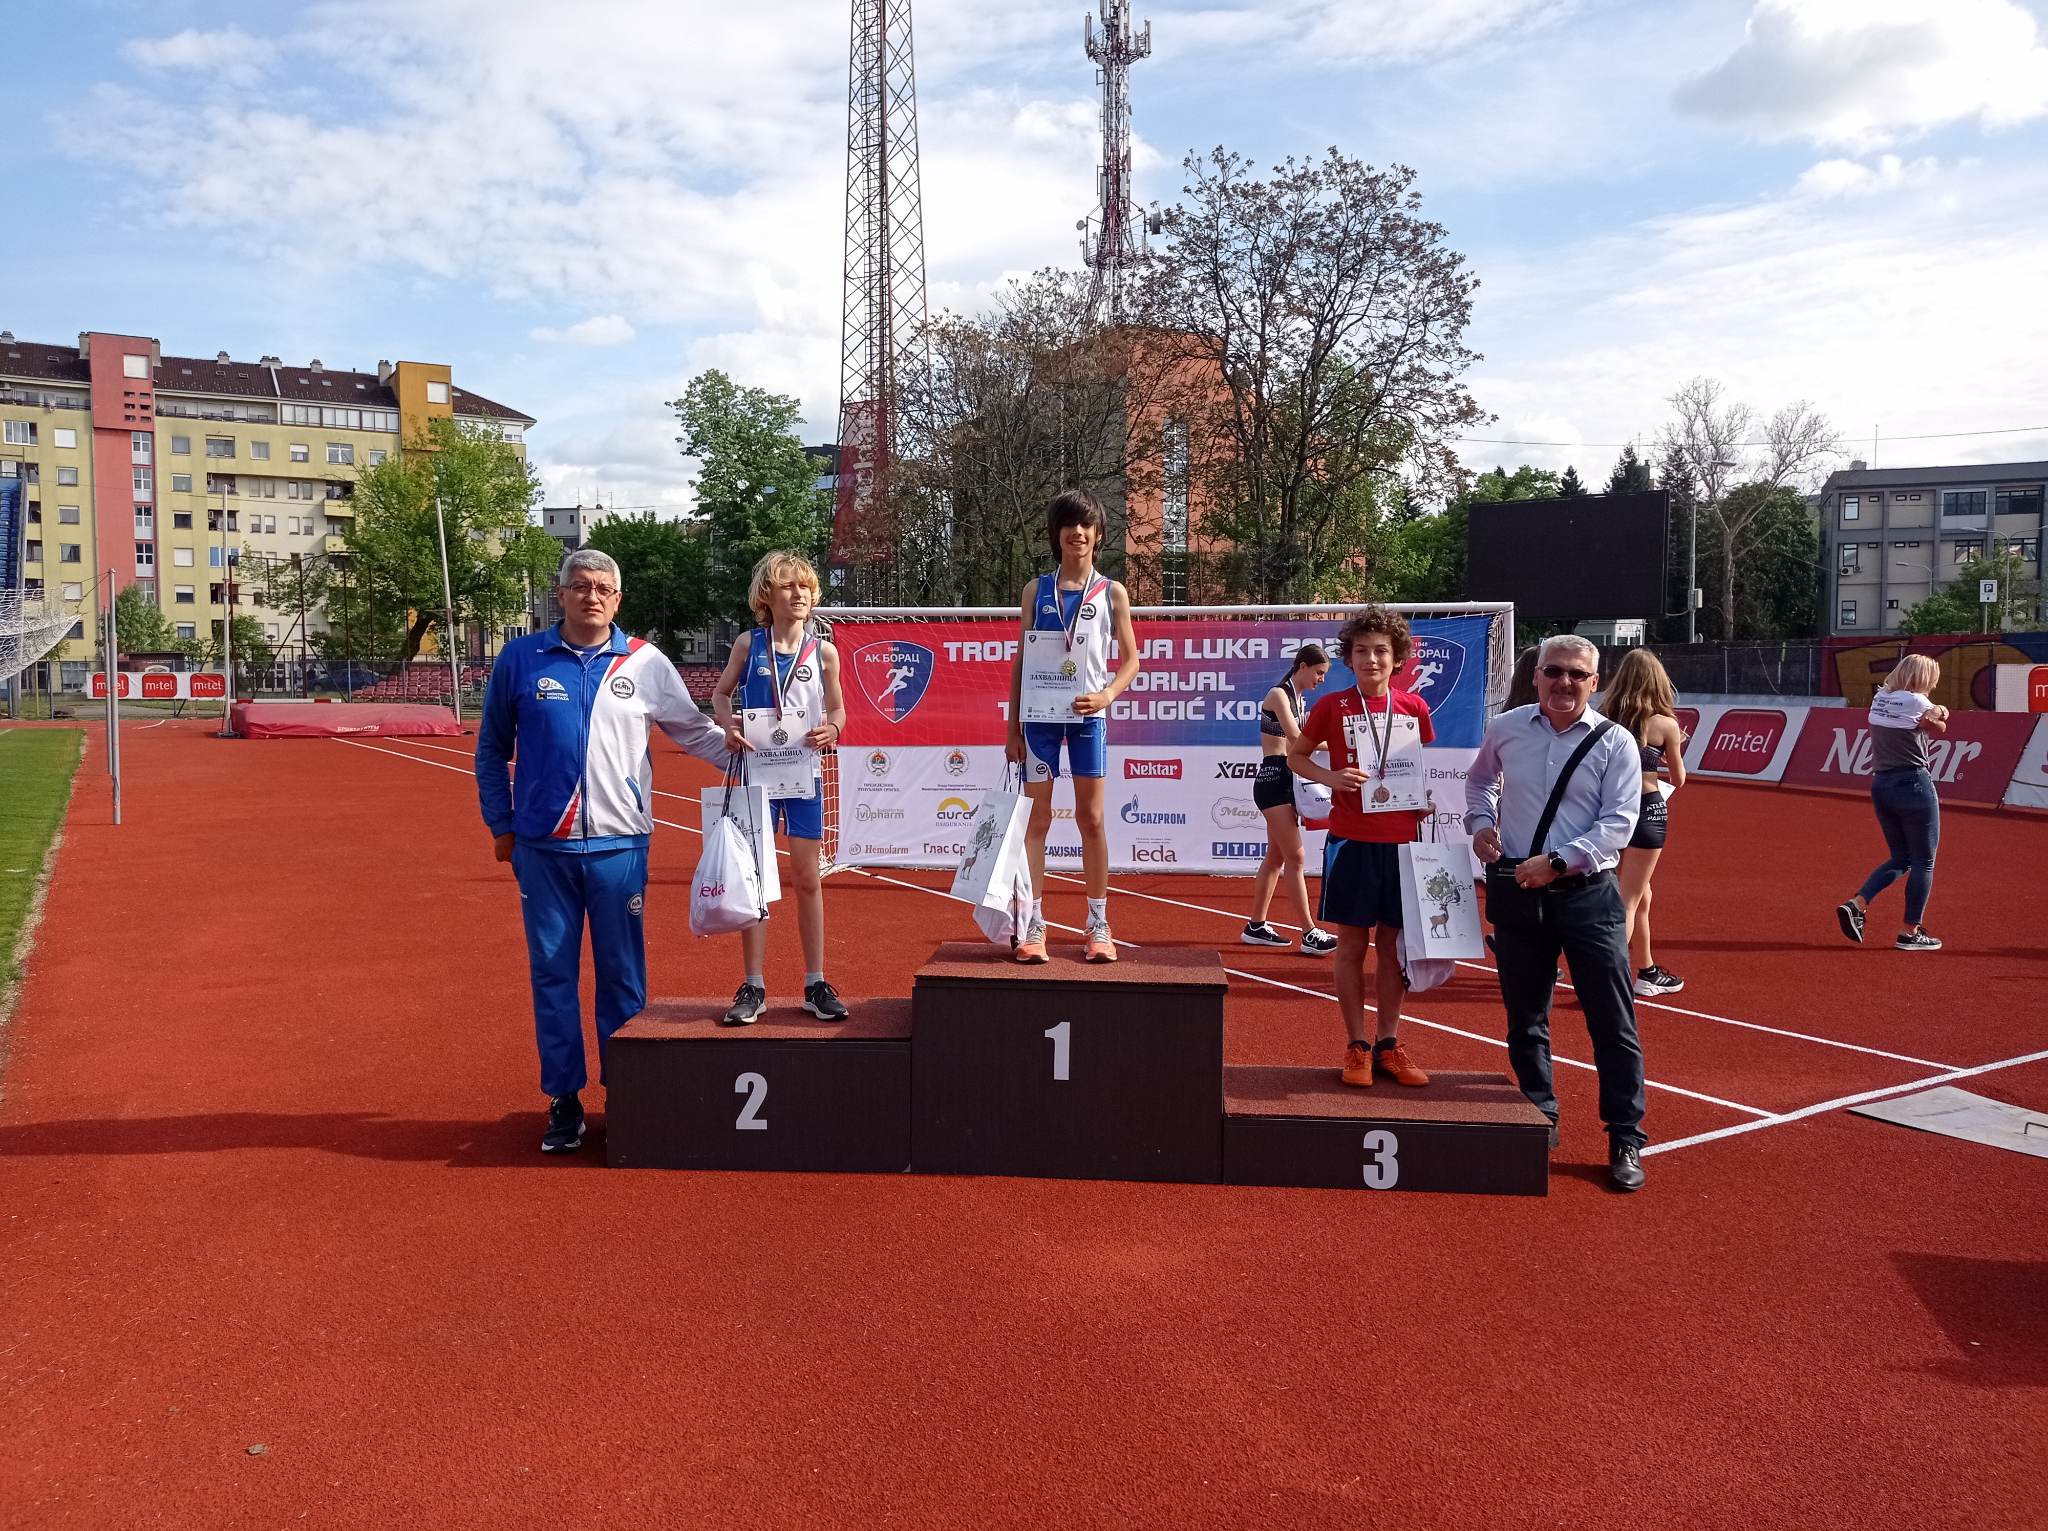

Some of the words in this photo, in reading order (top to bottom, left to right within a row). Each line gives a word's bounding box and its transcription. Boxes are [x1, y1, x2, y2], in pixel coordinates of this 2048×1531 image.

[943, 641, 1019, 662] TROF
[1184, 638, 1269, 659] LUKA
[865, 654, 880, 663] АК
[883, 654, 920, 664] БОРАЦ
[145, 681, 174, 691] m:tel
[194, 681, 222, 691] m:tel
[1111, 697, 1206, 721] GLIGIĆ
[1714, 728, 1774, 754] m:tel
[1129, 762, 1178, 776] Nektar
[1430, 768, 1467, 780] Banka
[936, 811, 973, 820] aura
[1140, 813, 1186, 825] GAZPROM
[865, 845, 909, 854] Hemofarm
[923, 843, 949, 854] Глас
[952, 843, 966, 856] Ср
[1132, 844, 1177, 862] leda
[1045, 1021, 1071, 1081] 1
[734, 1072, 768, 1130] 2
[1363, 1129, 1399, 1190] 3
